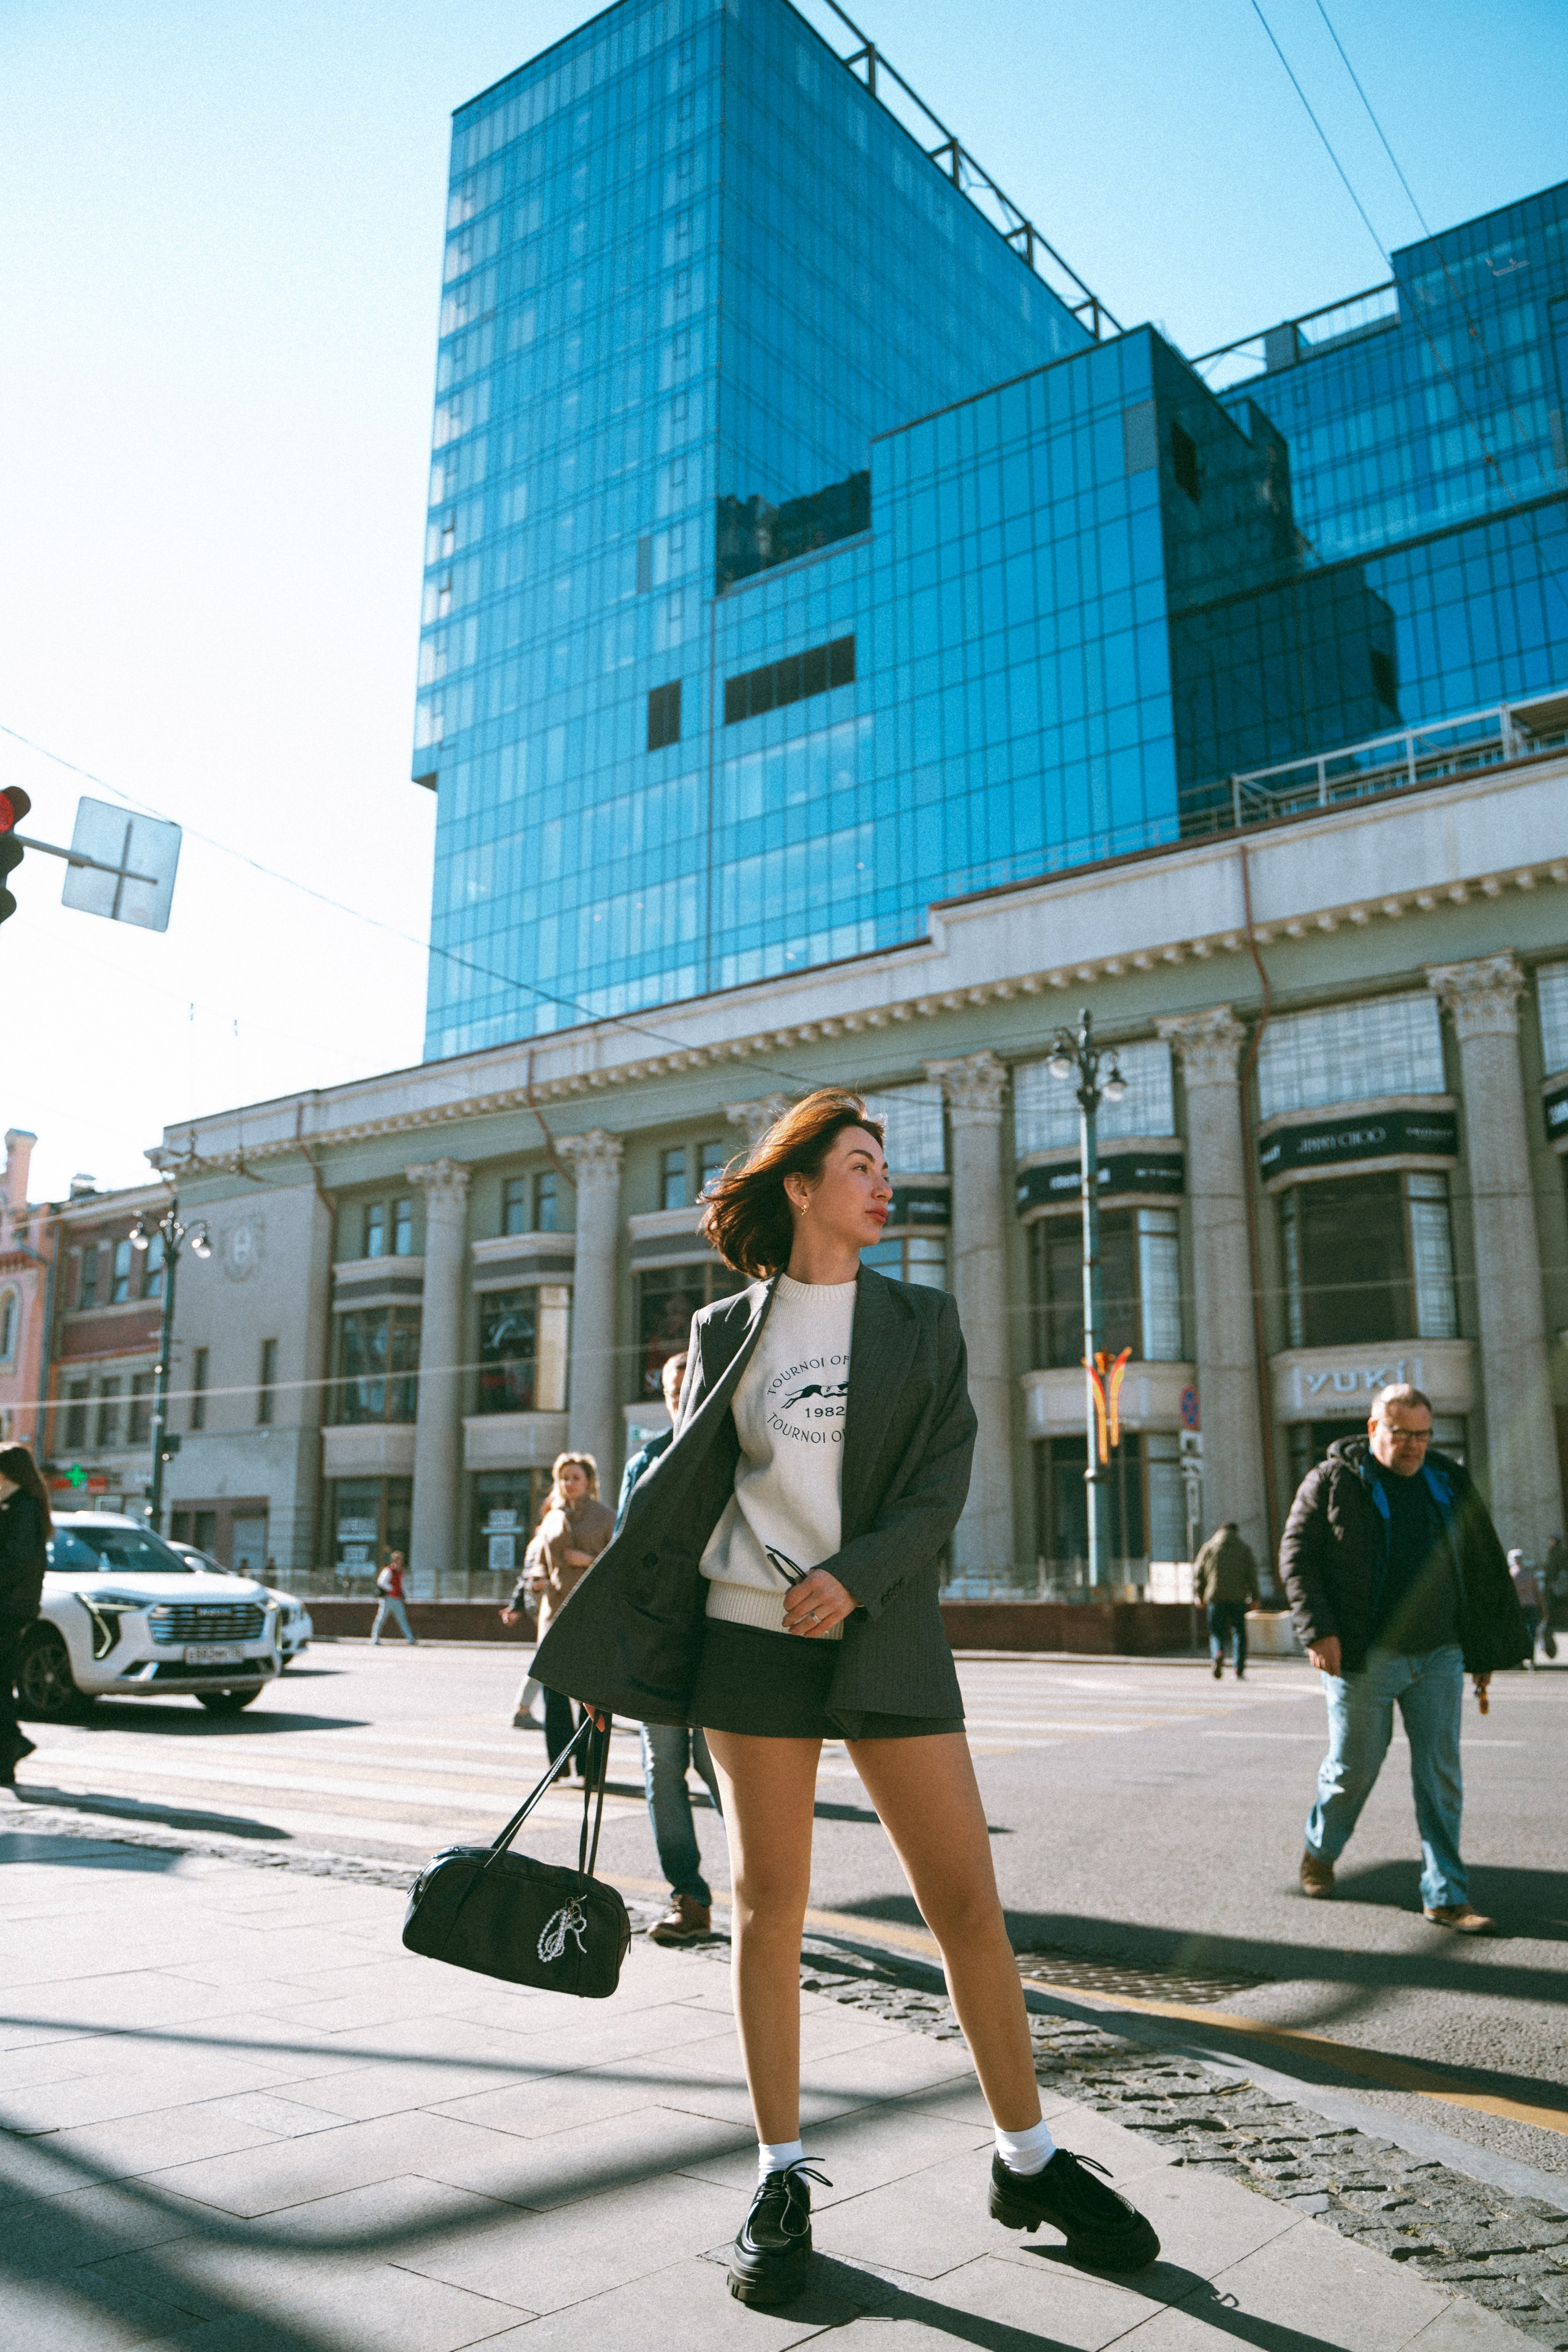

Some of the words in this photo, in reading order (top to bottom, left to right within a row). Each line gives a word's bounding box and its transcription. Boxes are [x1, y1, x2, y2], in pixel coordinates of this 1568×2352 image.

[767, 1358, 824, 1395] TOURNOI
[831, 1355, 850, 1365] OF
[767, 1412, 826, 1444] TOURNOI
[805, 1406, 845, 1418] 1982
